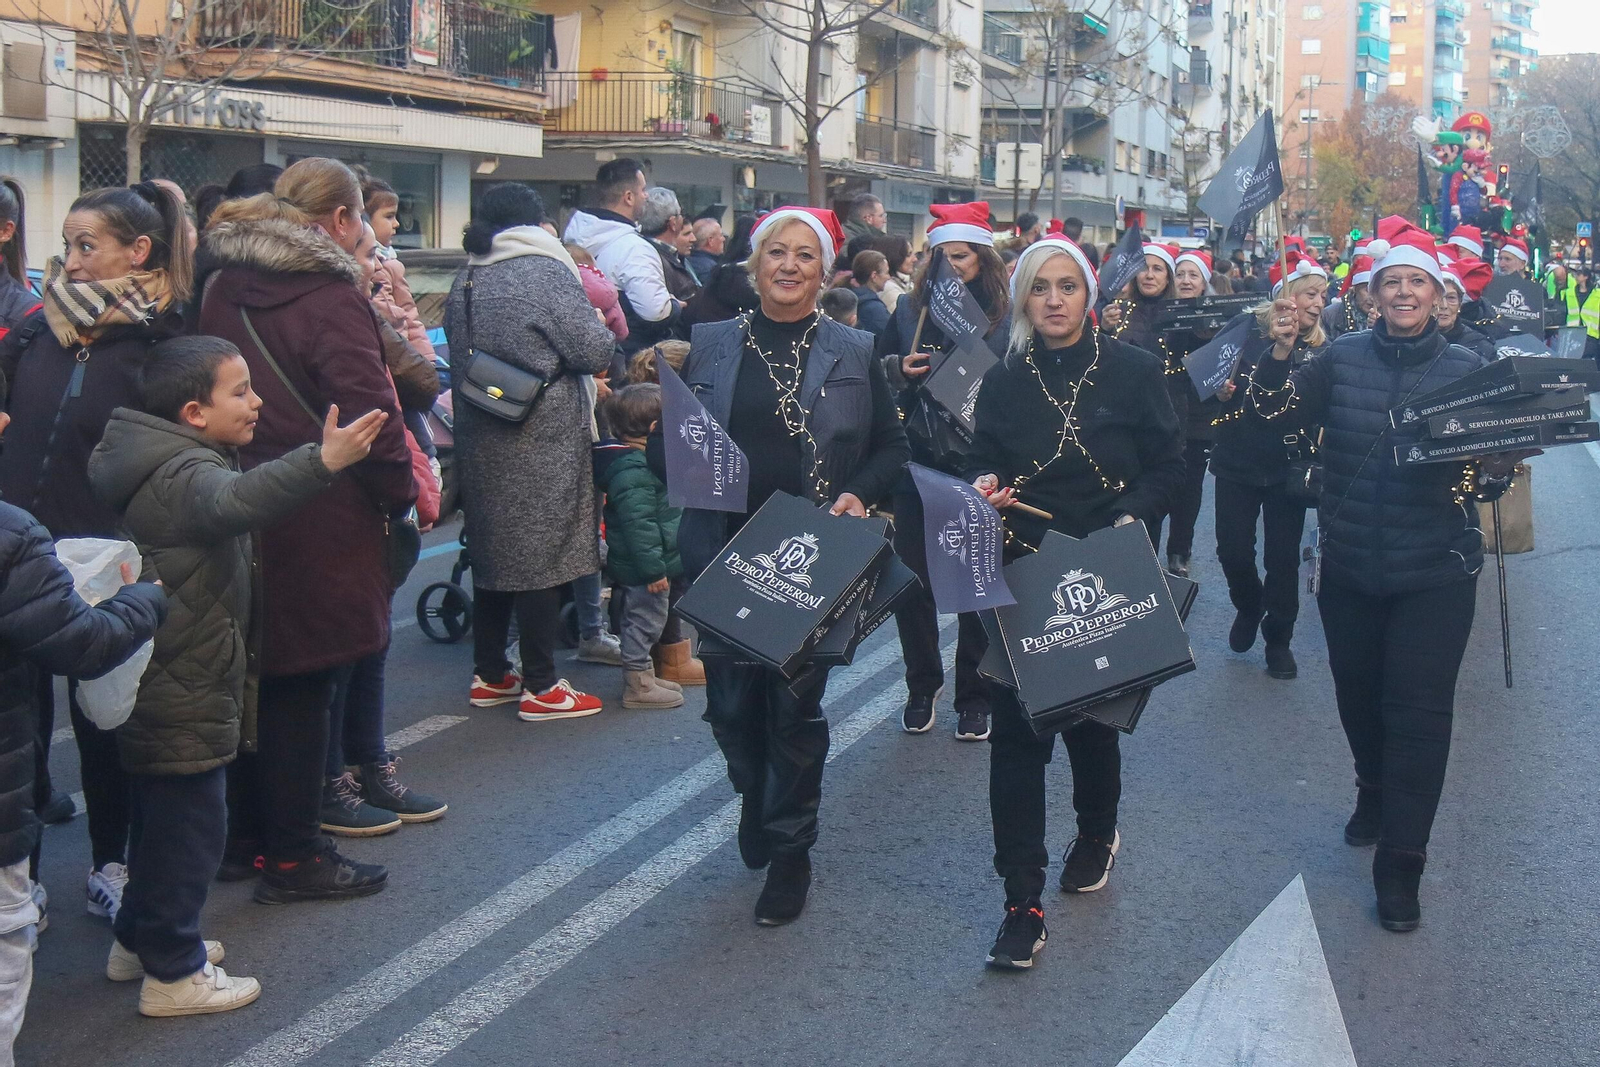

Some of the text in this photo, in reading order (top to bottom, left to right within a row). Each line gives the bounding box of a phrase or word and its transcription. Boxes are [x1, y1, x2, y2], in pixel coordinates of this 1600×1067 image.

[1421, 404, 1445, 416] SERVICIO
[1450, 394, 1479, 408] DOMICILIO
[1484, 388, 1499, 398] TAKE
[1499, 384, 1516, 393] AWAY
[1468, 418, 1499, 429] SERVICIO
[1505, 415, 1540, 425] DOMICILIO
[1547, 411, 1564, 420] TAKE
[1564, 409, 1585, 418] AWAY
[1428, 447, 1456, 457] SERVICIO
[1461, 440, 1494, 451] DOMICILIO
[1500, 438, 1516, 446] TAKE
[724, 552, 826, 609] PEDROPEPPERONI
[846, 592, 857, 606] 870
[1020, 592, 1160, 653] PEDROPEPPERONI
[1089, 630, 1104, 640] Pizza
[1105, 622, 1127, 633] Italiana
